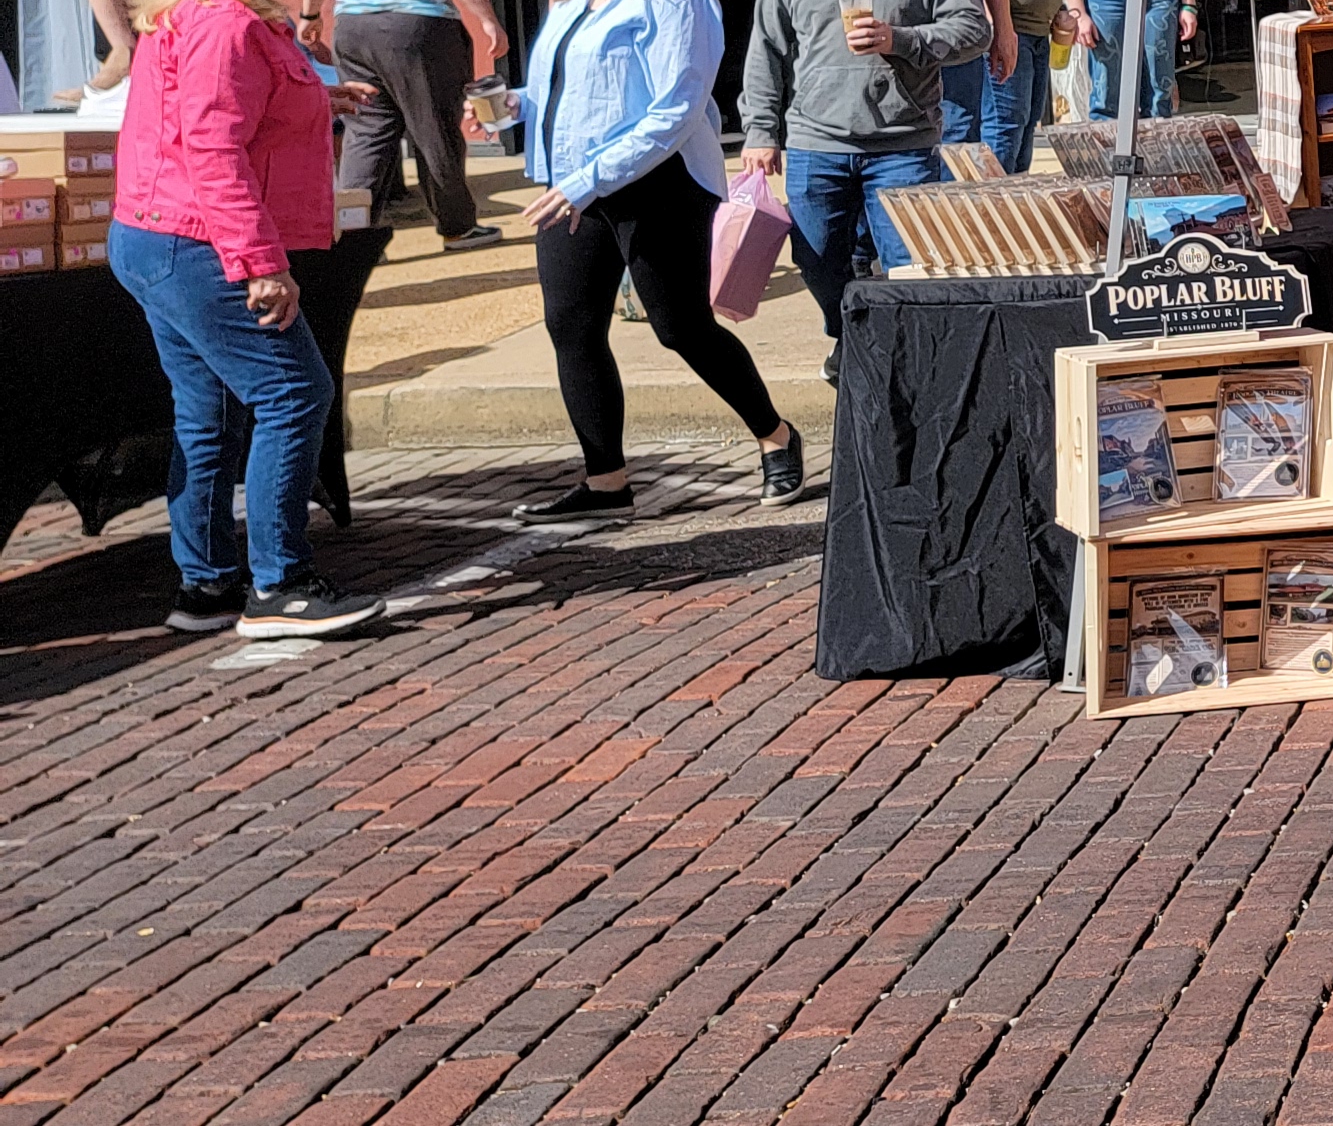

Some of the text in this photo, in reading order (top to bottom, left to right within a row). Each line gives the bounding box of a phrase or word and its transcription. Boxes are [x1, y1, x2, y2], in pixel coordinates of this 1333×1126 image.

[1185, 252, 1203, 264] HPB
[1106, 275, 1286, 316] POPLAR BLUFF
[1160, 308, 1241, 323] MISSOURI
[1098, 403, 1124, 415] OPLAR
